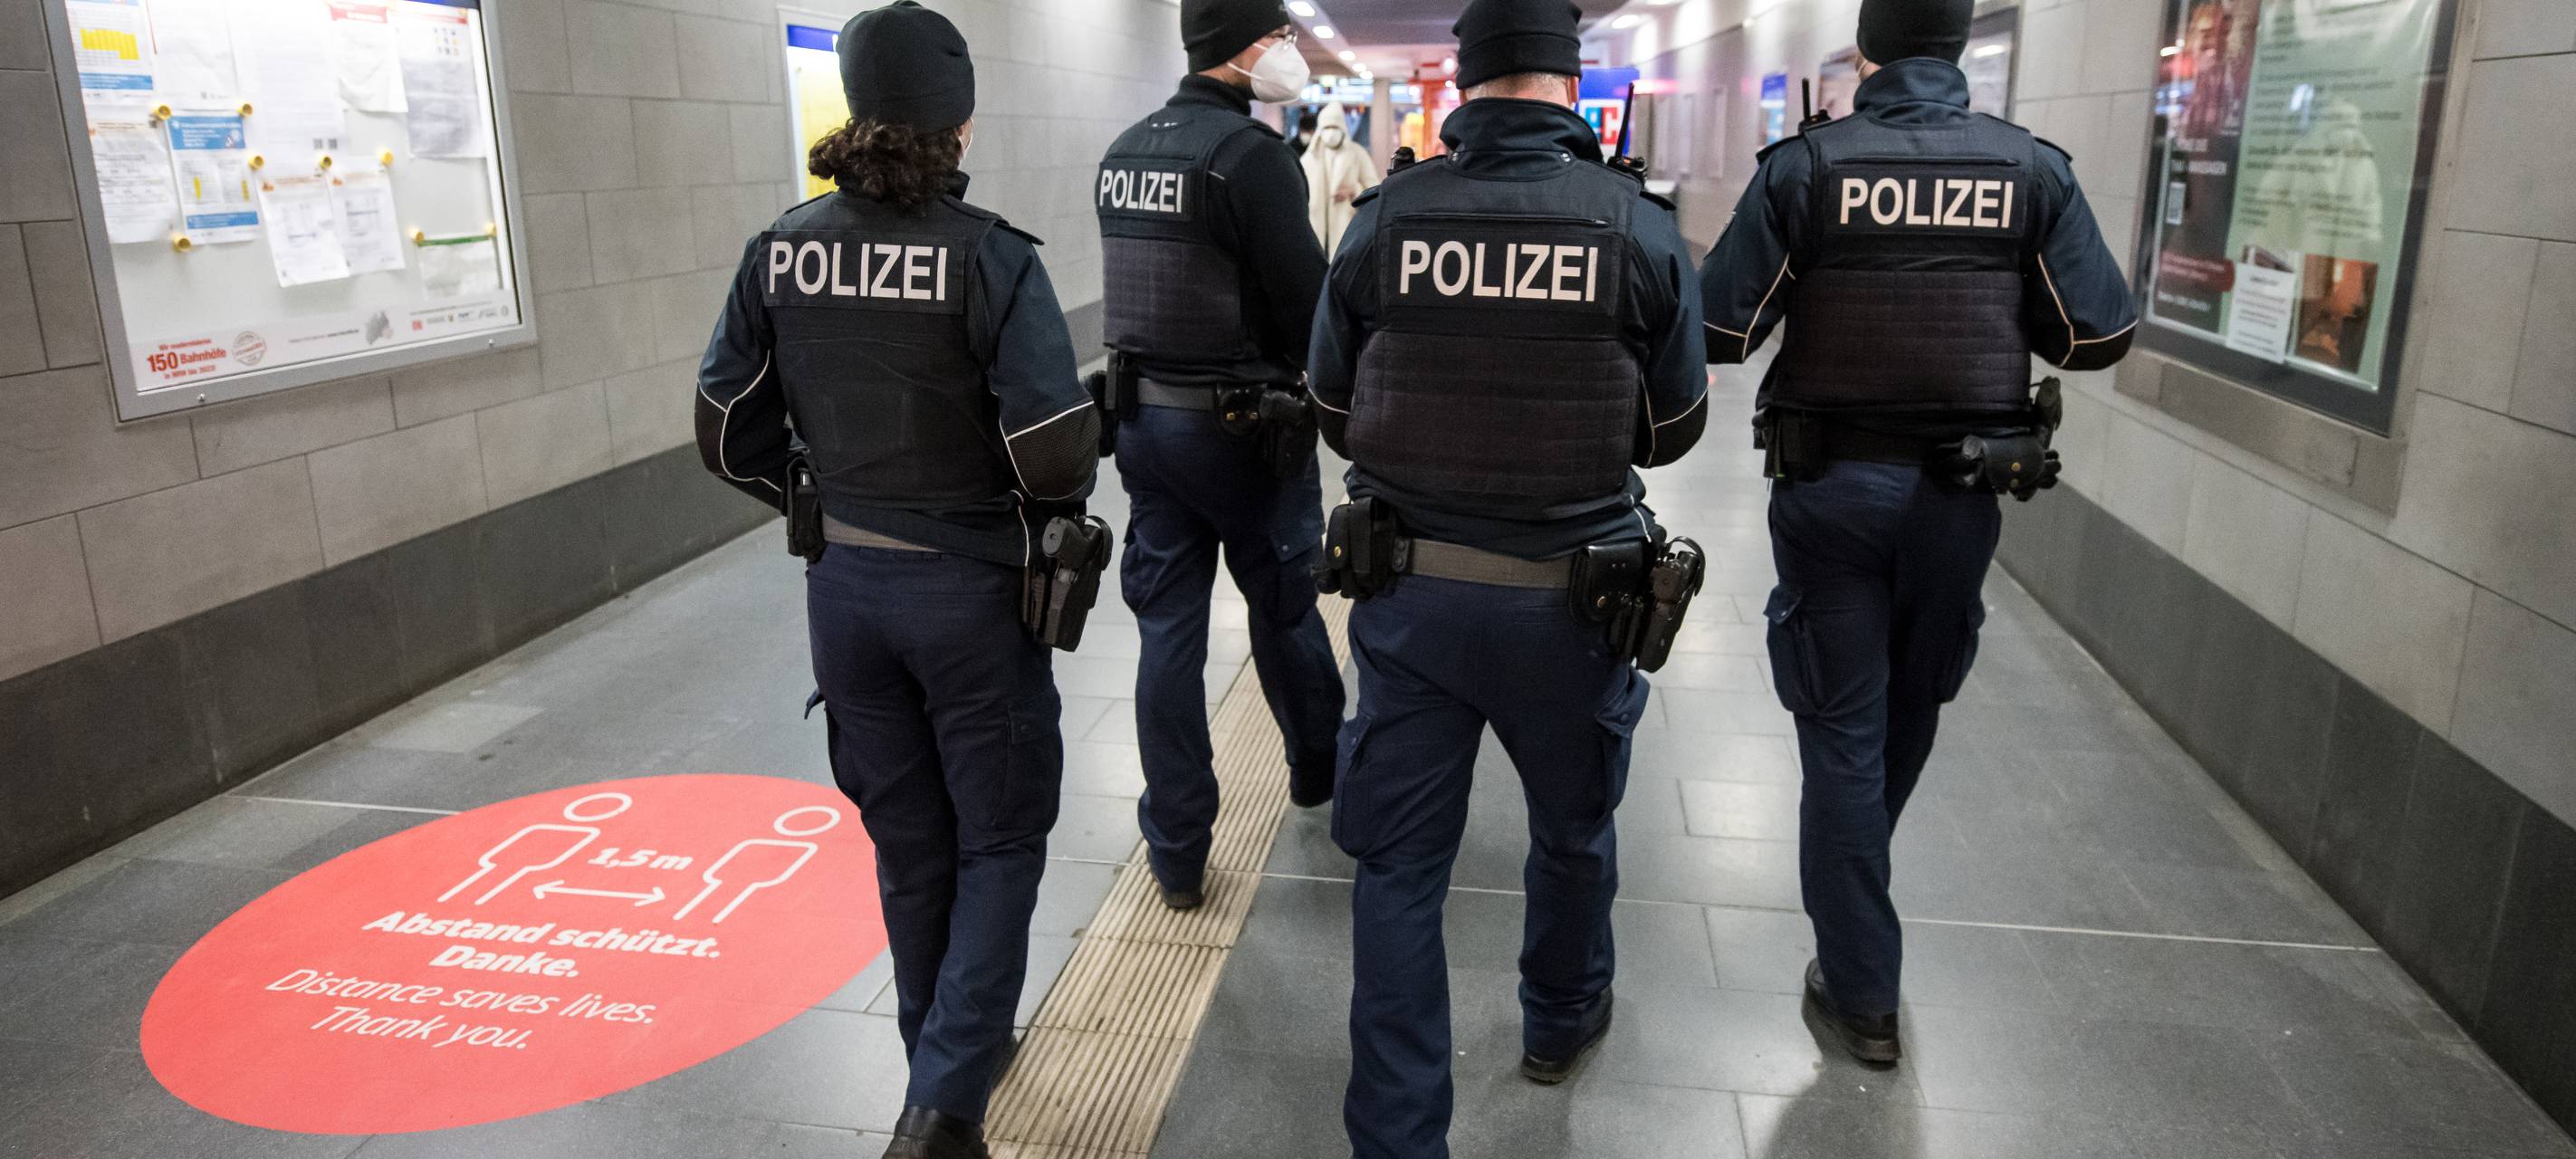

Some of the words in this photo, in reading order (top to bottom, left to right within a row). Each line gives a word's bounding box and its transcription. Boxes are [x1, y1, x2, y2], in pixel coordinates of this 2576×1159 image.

[1099, 169, 1183, 214] POLIZEI
[1841, 177, 2014, 228] POLIZEI
[770, 241, 947, 301] POLIZEI
[1401, 241, 1599, 302] POLIZEI
[147, 351, 178, 372] 150
[180, 349, 226, 364] Bahnhöfe
[362, 911, 556, 944] Abstand
[549, 927, 722, 959] schützt.
[429, 944, 579, 978] Danke.
[265, 969, 444, 1004] Distance
[439, 989, 560, 1015] saves
[558, 992, 656, 1025] lives.
[311, 1005, 449, 1040] Thank
[432, 1023, 533, 1049] you.
